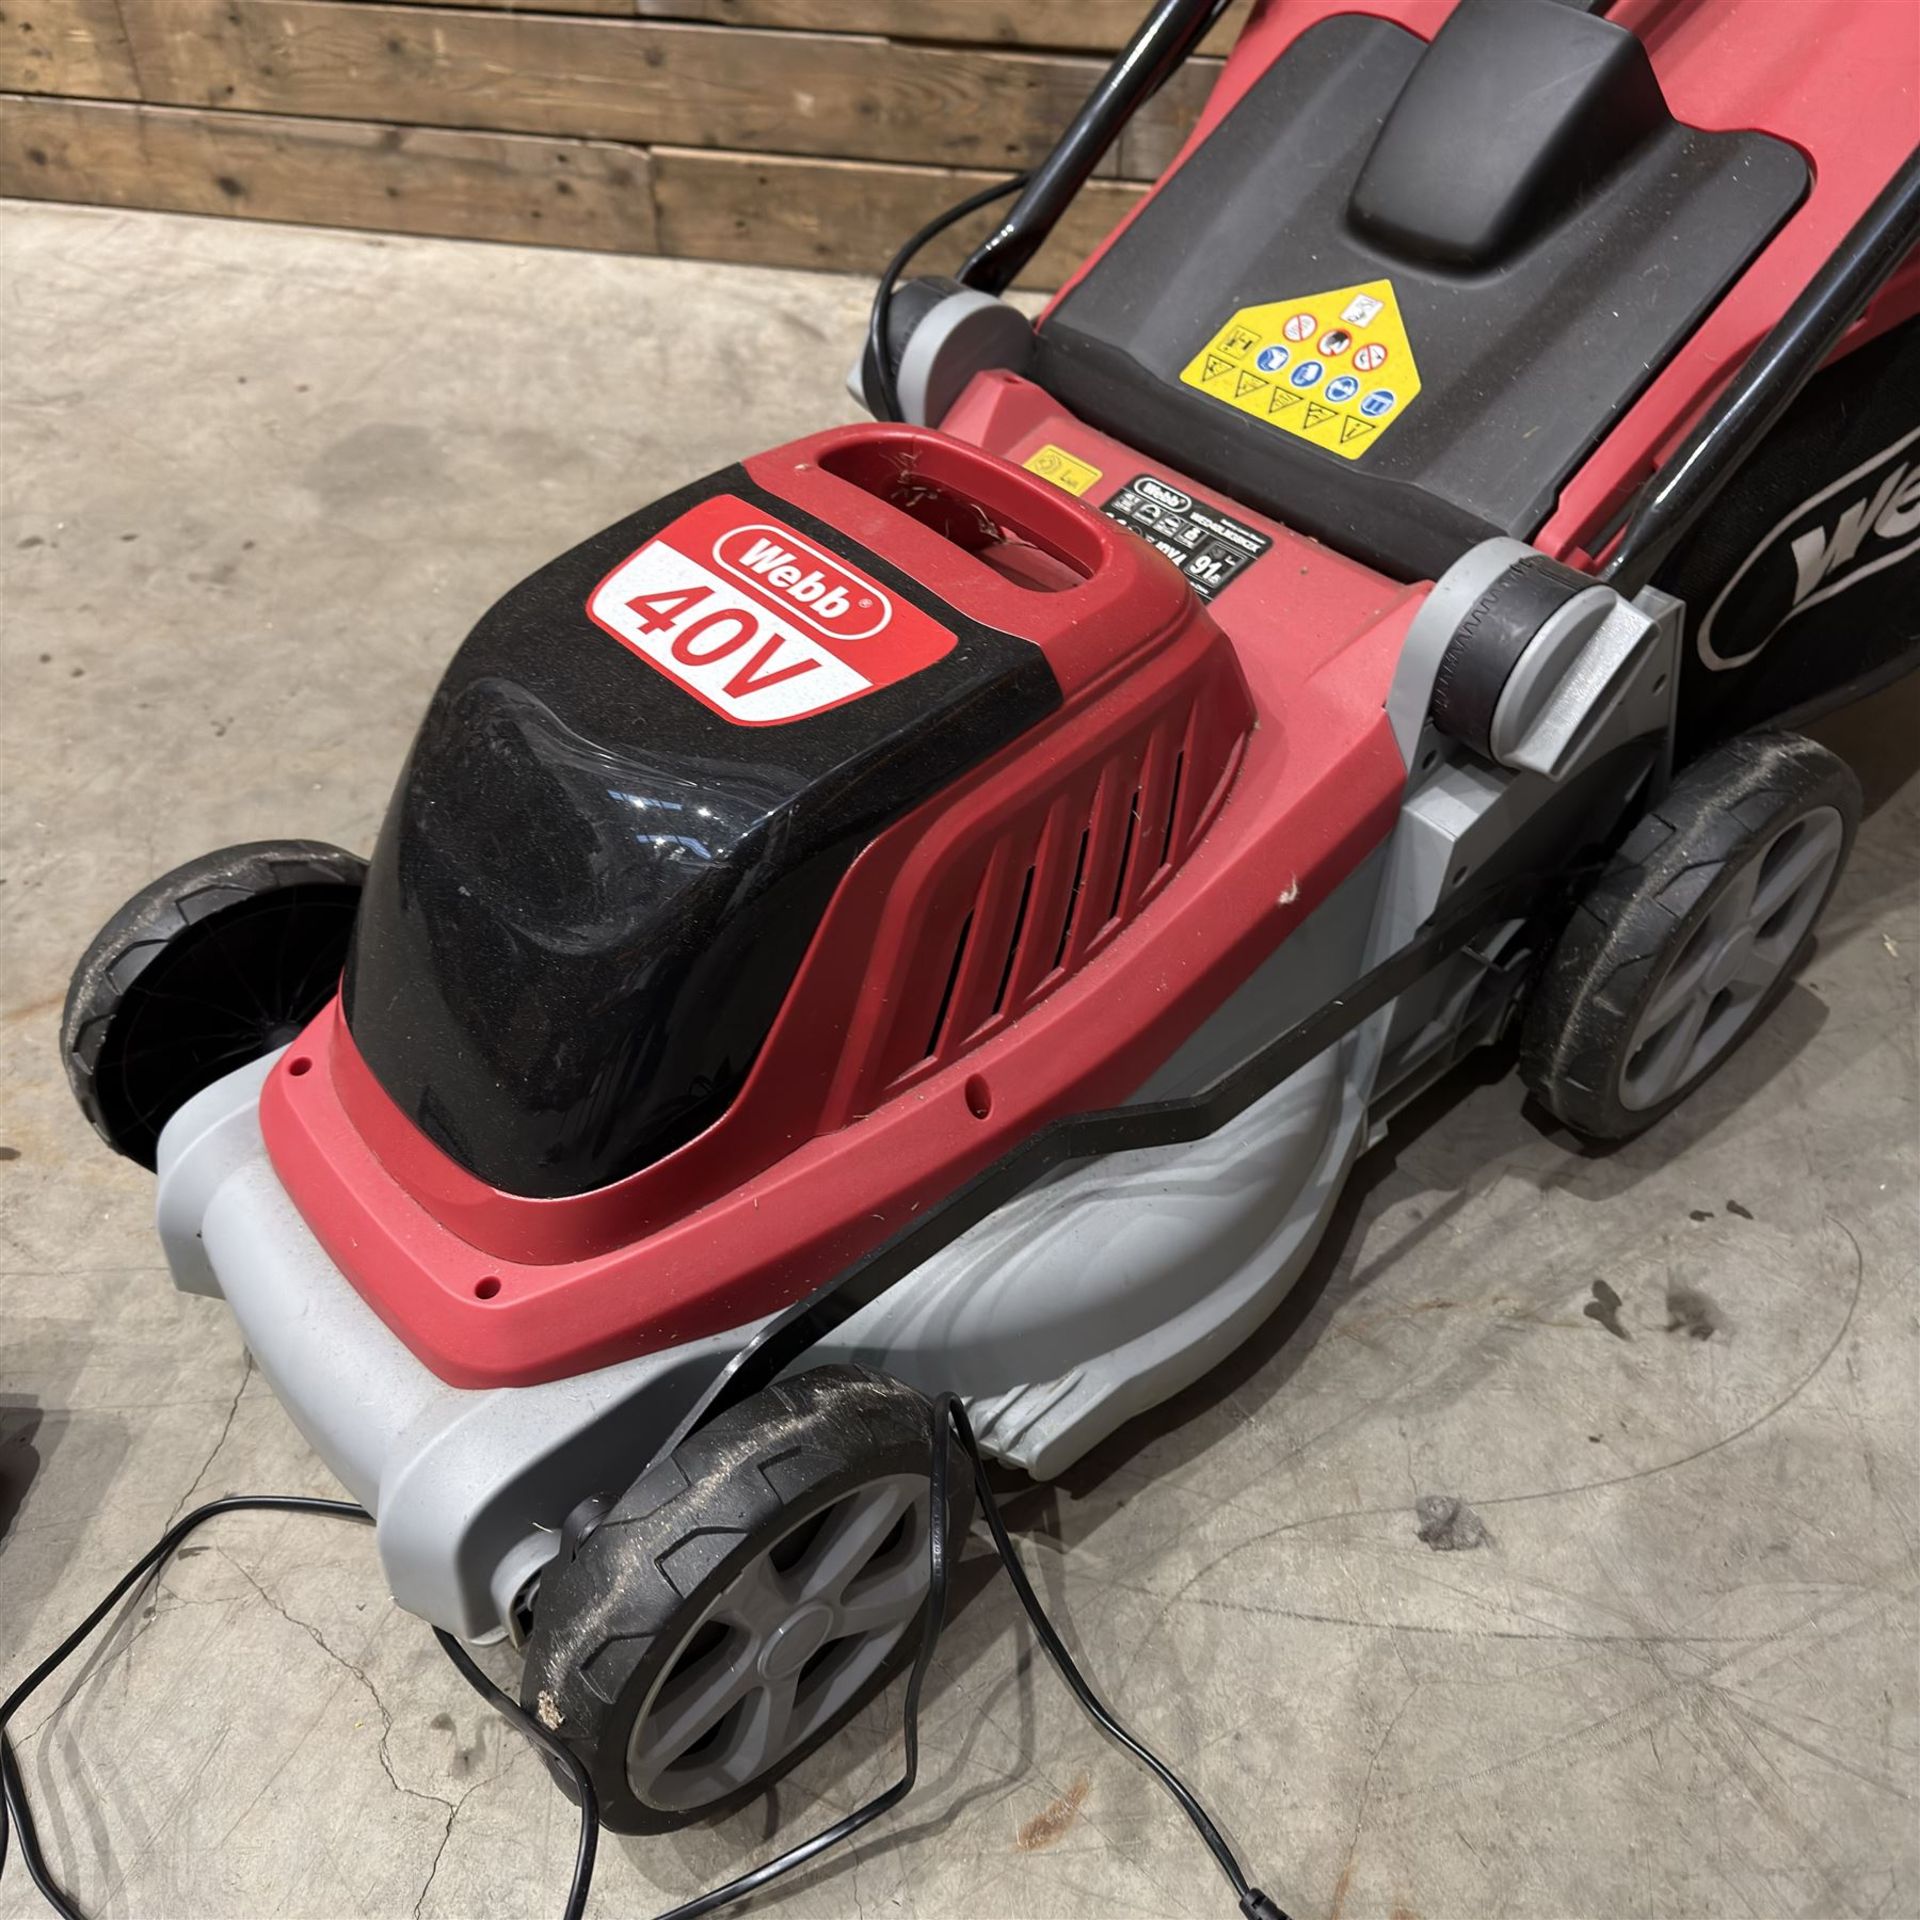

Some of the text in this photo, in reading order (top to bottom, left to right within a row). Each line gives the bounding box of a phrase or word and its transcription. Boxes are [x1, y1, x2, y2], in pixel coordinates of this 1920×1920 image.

[1143, 482, 1180, 507] Webb
[738, 538, 851, 618] Webb
[1190, 556, 1222, 579] 91
[625, 586, 822, 699] 40V
